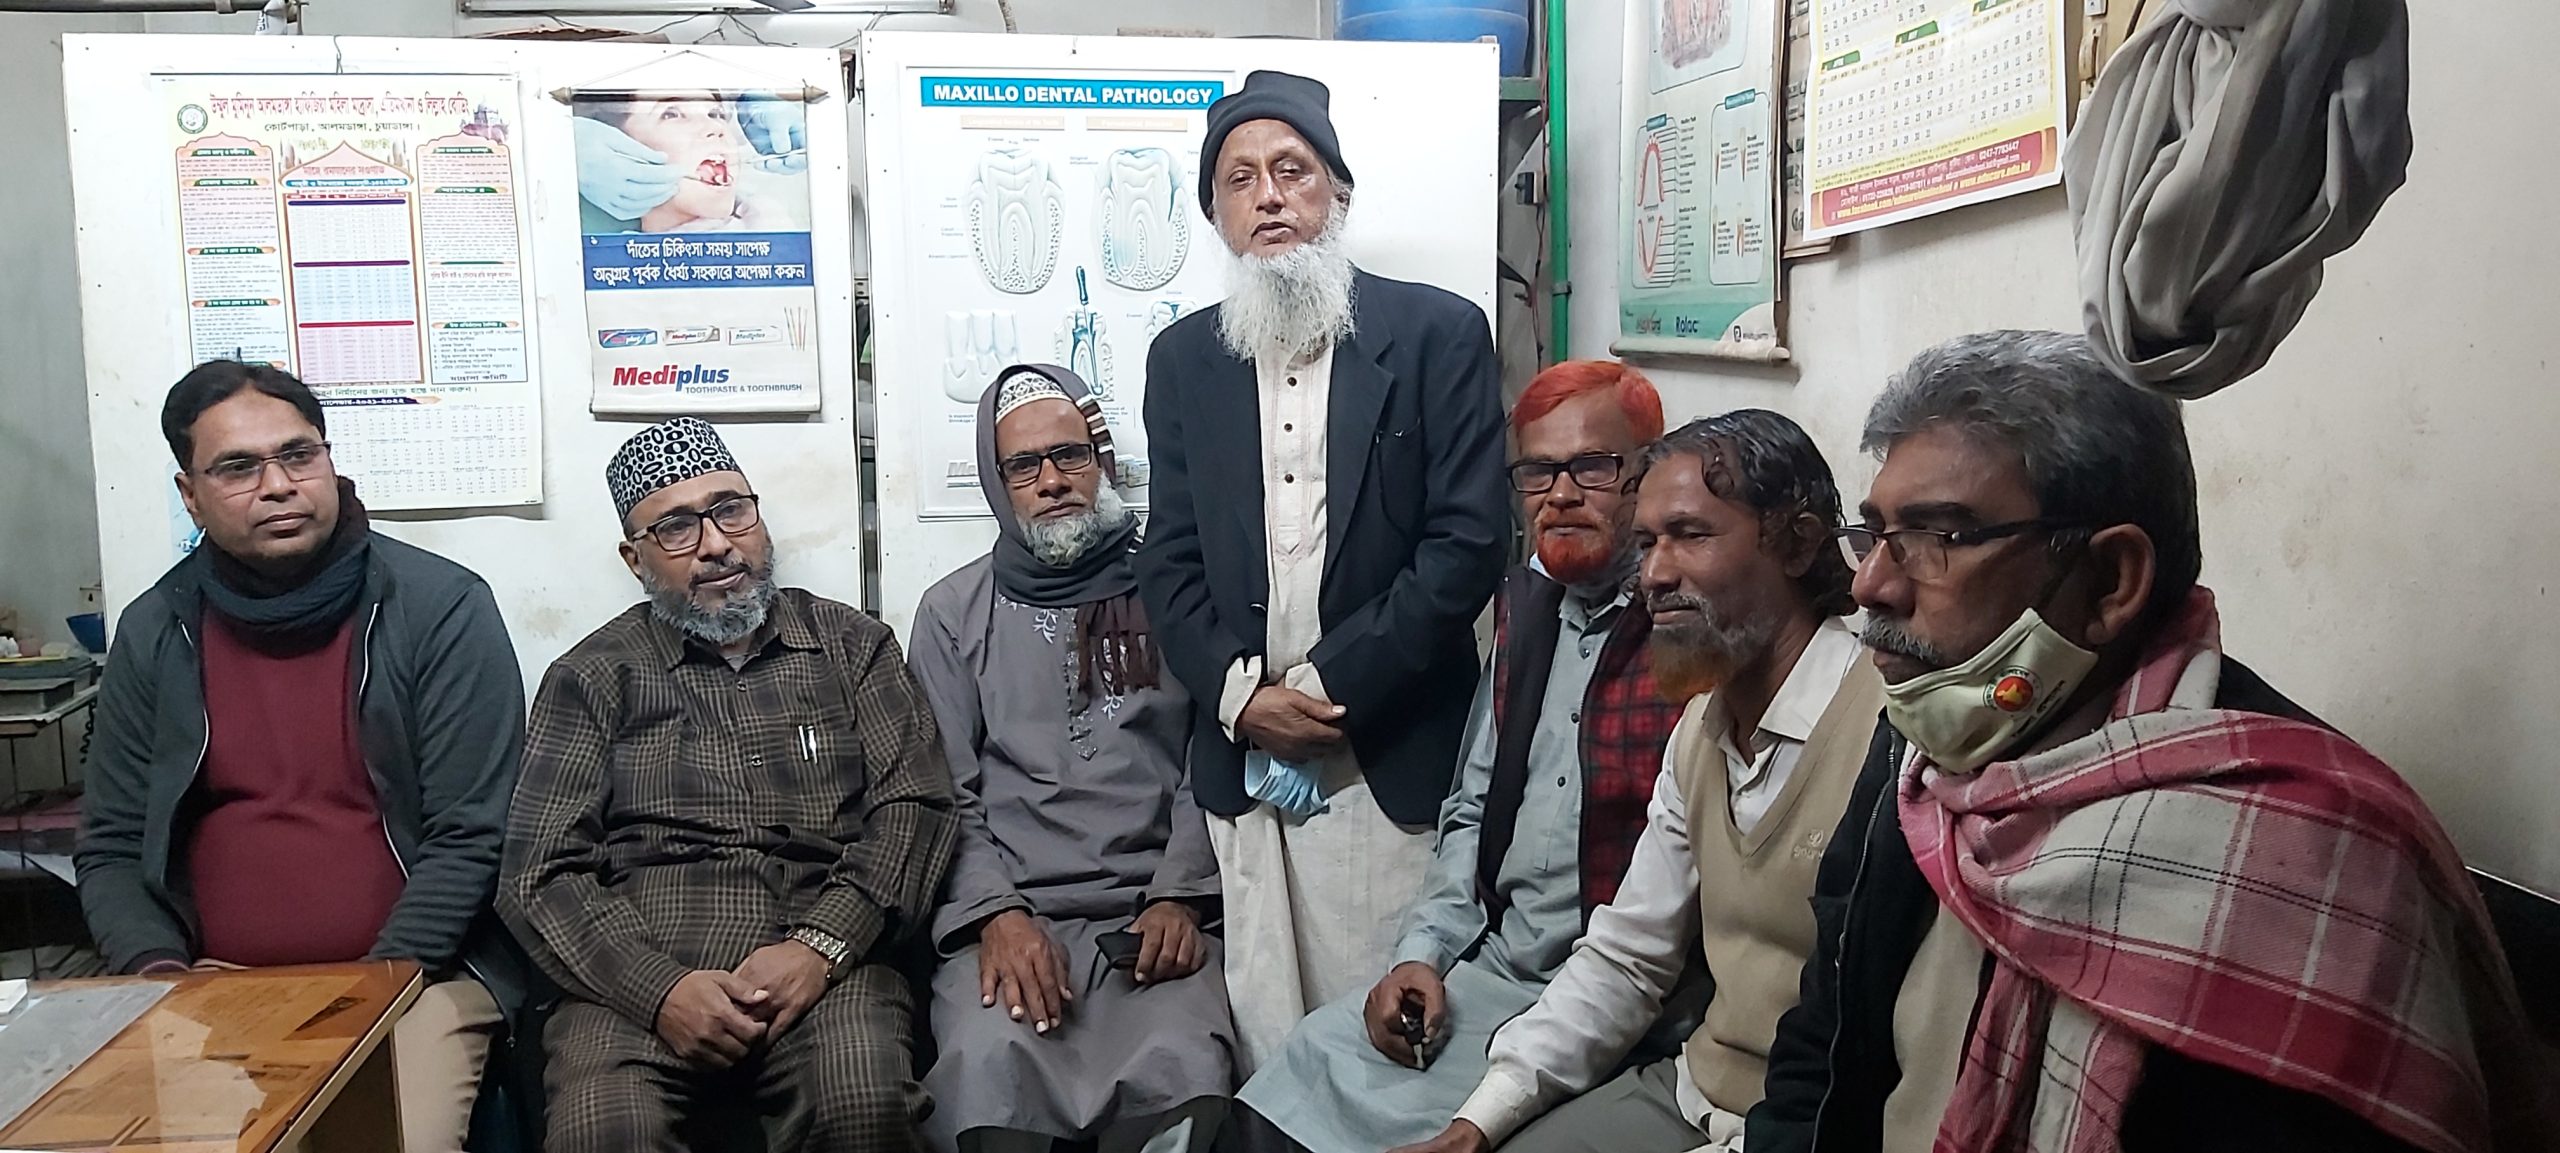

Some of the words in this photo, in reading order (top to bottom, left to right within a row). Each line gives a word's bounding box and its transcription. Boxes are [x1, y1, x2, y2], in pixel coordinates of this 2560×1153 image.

[933, 84, 1019, 102] MAXILLO
[1024, 86, 1097, 103] DENTAL
[1102, 87, 1212, 104] PATHOLOGY
[626, 239, 660, 258] দাঁতের
[662, 238, 703, 258] চিকিৎসা
[705, 241, 733, 257] সময়
[734, 241, 770, 256] সাপেক্ষ
[592, 266, 631, 287] অনুগ্রহ
[632, 263, 661, 285] পূর্বক
[691, 265, 732, 280] সহকারে
[734, 264, 772, 280] অপেক্ষা
[774, 264, 805, 279] করুন
[1676, 315, 1699, 333] Rolac
[613, 364, 729, 392] Mediplus
[686, 385, 737, 394] TOOTHPASTE
[747, 384, 802, 392] TOOTHBRUSH
